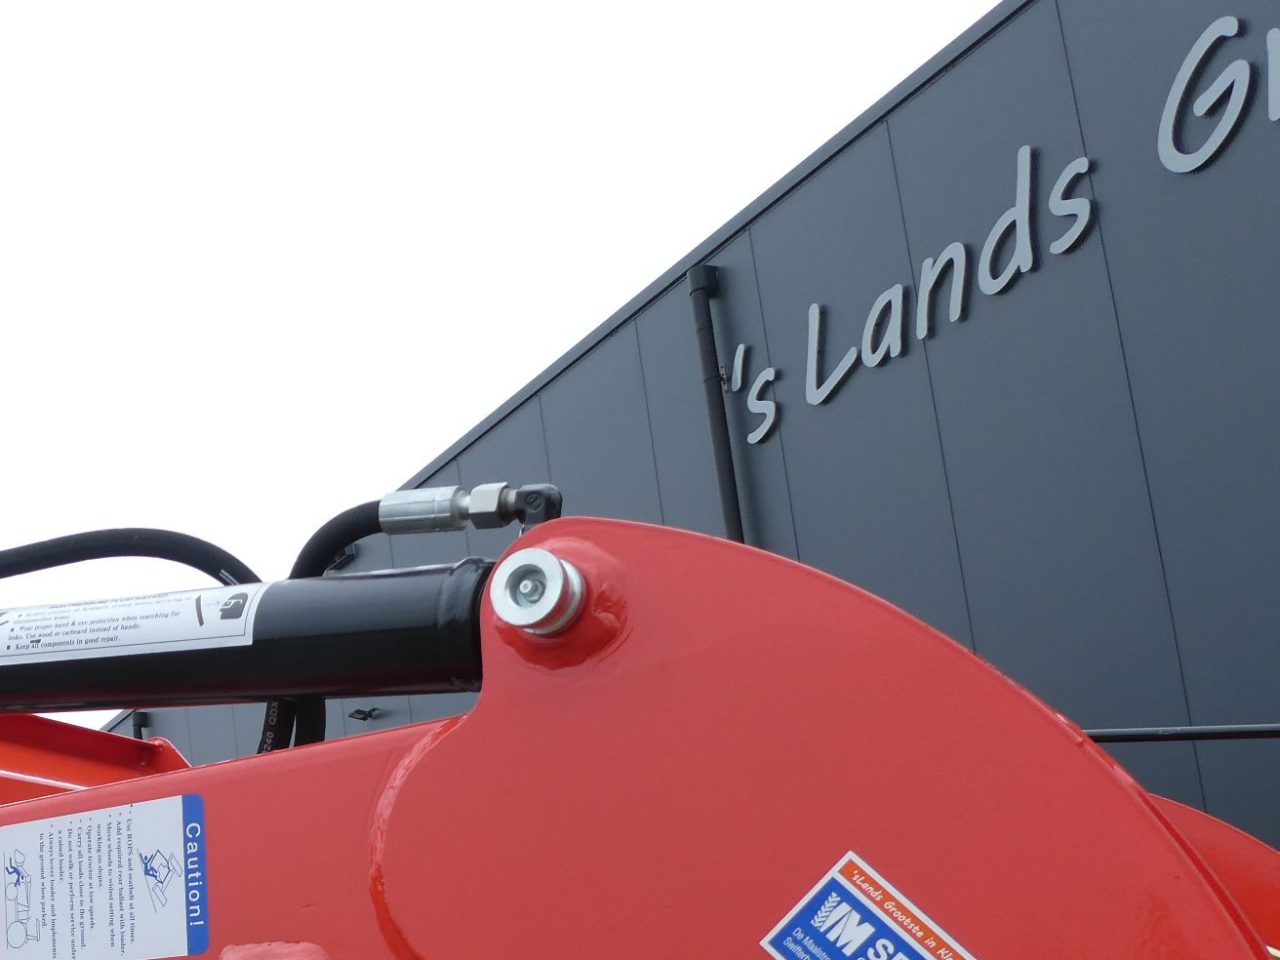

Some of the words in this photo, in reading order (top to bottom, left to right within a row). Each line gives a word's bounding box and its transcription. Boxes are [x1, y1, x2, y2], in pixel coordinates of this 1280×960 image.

[731, 343, 776, 444] 's
[805, 145, 1092, 405] Lands
[40, 639, 75, 648] components
[84, 637, 99, 645] good
[185, 822, 204, 927] Caution!
[130, 902, 134, 910] at
[792, 927, 802, 939] De
[883, 900, 924, 938] Grootste
[924, 936, 936, 949] in
